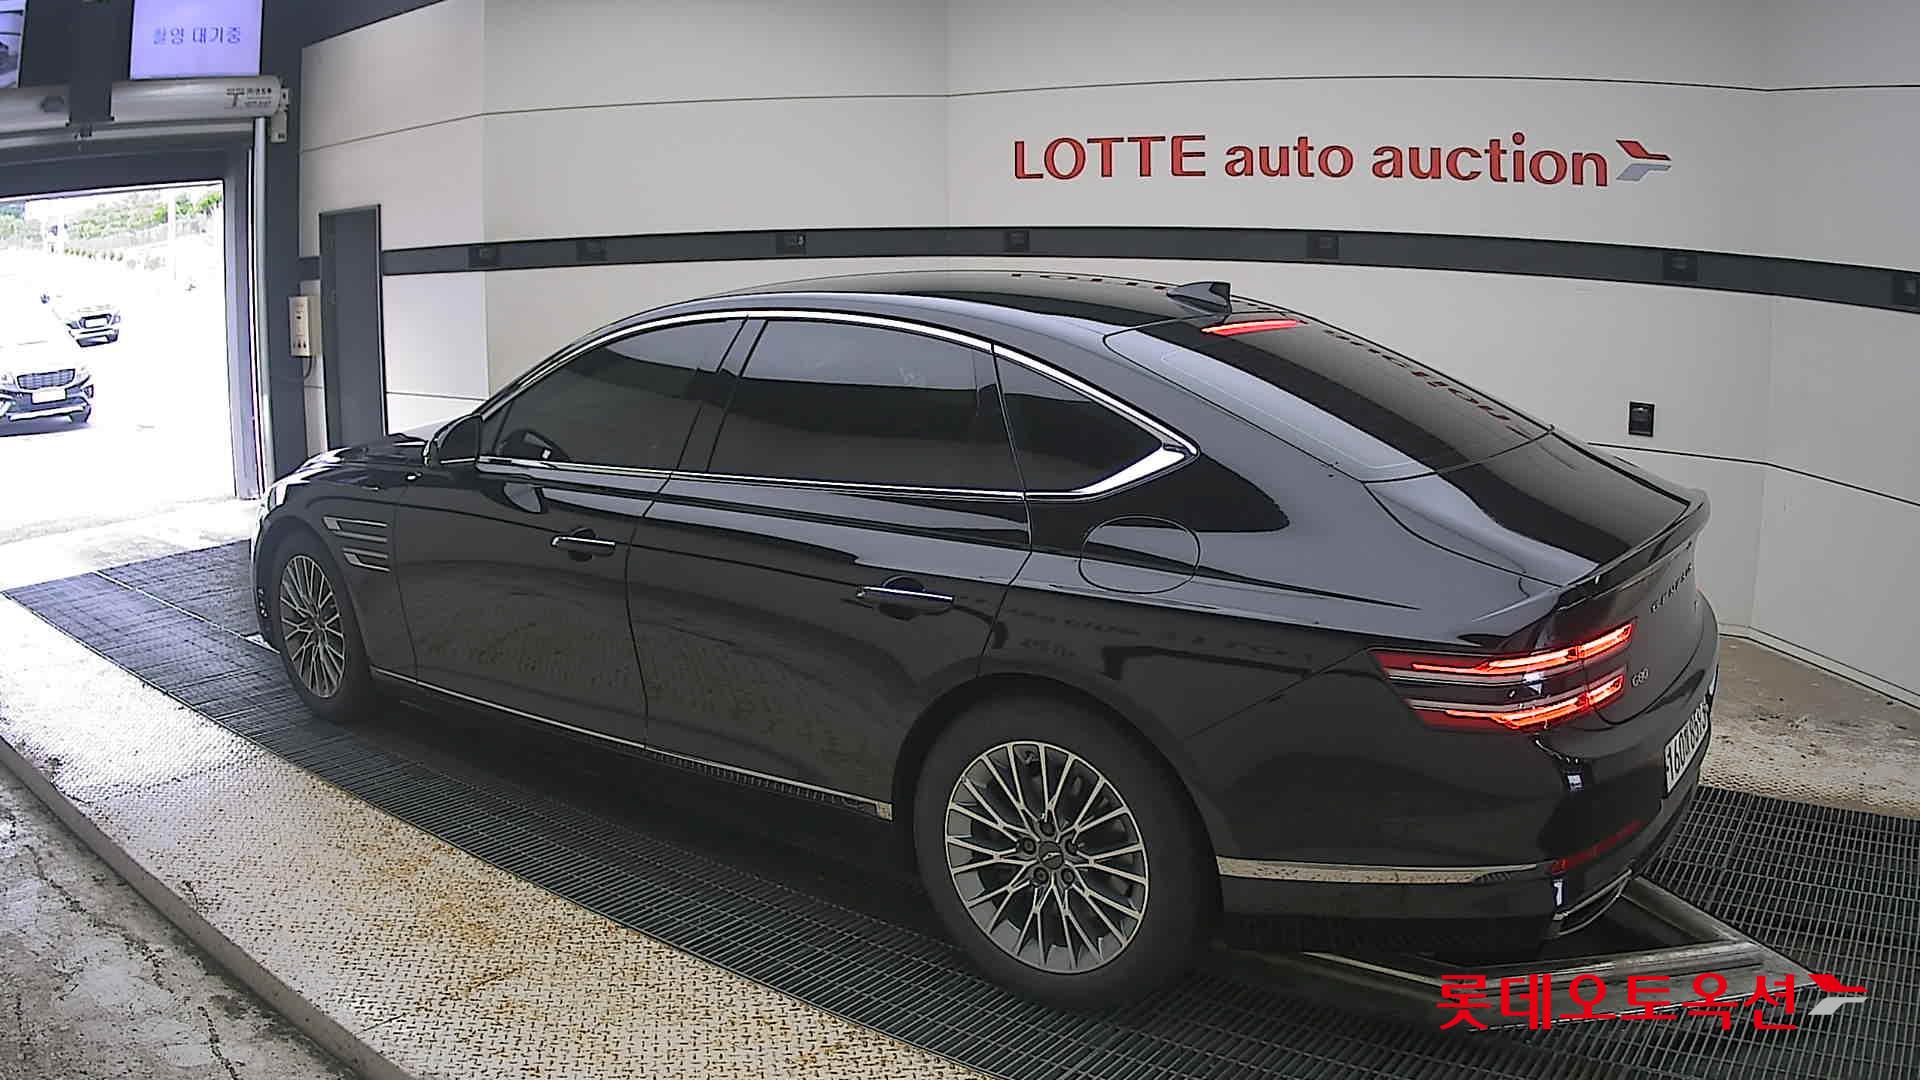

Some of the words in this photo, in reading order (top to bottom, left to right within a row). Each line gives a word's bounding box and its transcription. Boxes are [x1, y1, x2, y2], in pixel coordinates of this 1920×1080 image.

[1013, 135, 1206, 180] LOTTE
[1224, 136, 1355, 179] auto
[1371, 132, 1609, 187] auction
